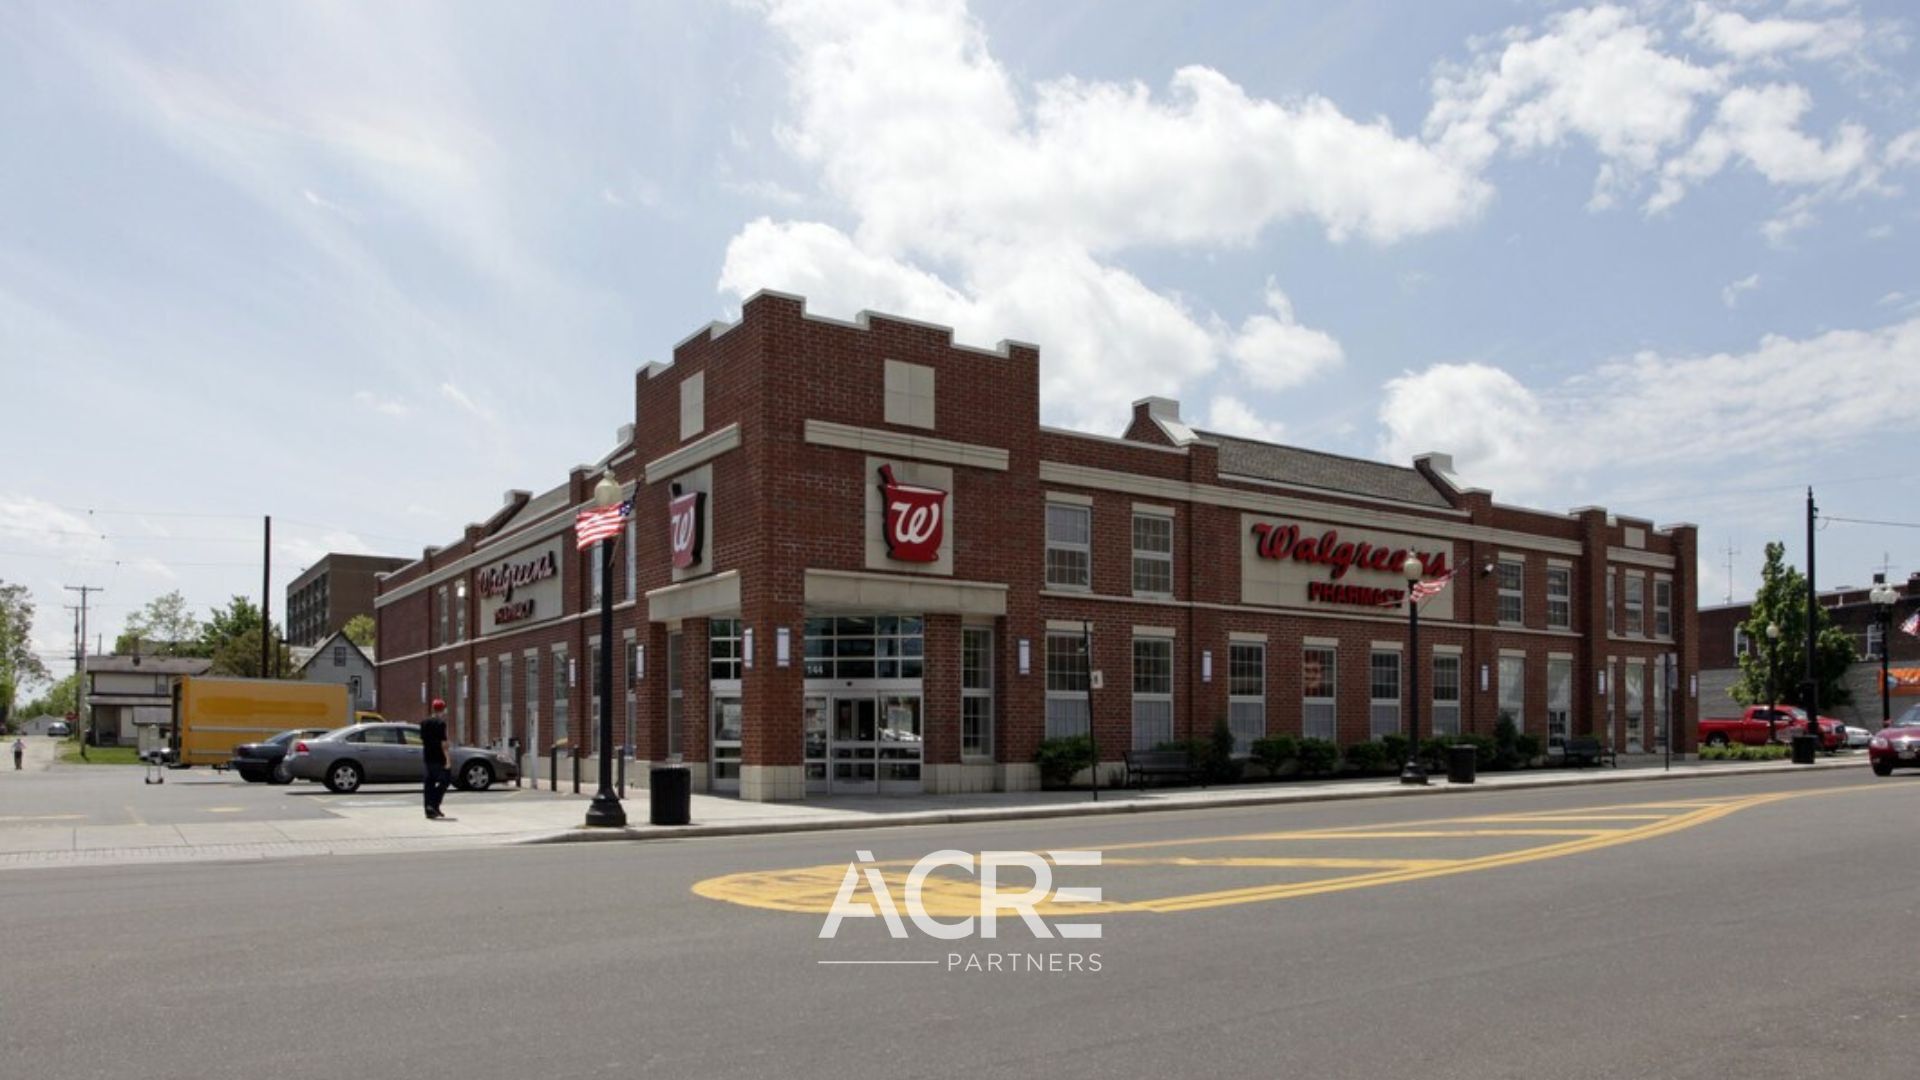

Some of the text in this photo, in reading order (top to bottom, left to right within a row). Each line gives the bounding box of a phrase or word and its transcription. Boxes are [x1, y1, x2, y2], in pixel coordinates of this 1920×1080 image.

[671, 505, 695, 553] W
[891, 502, 940, 544] W
[1307, 581, 1405, 608] PHARMACY
